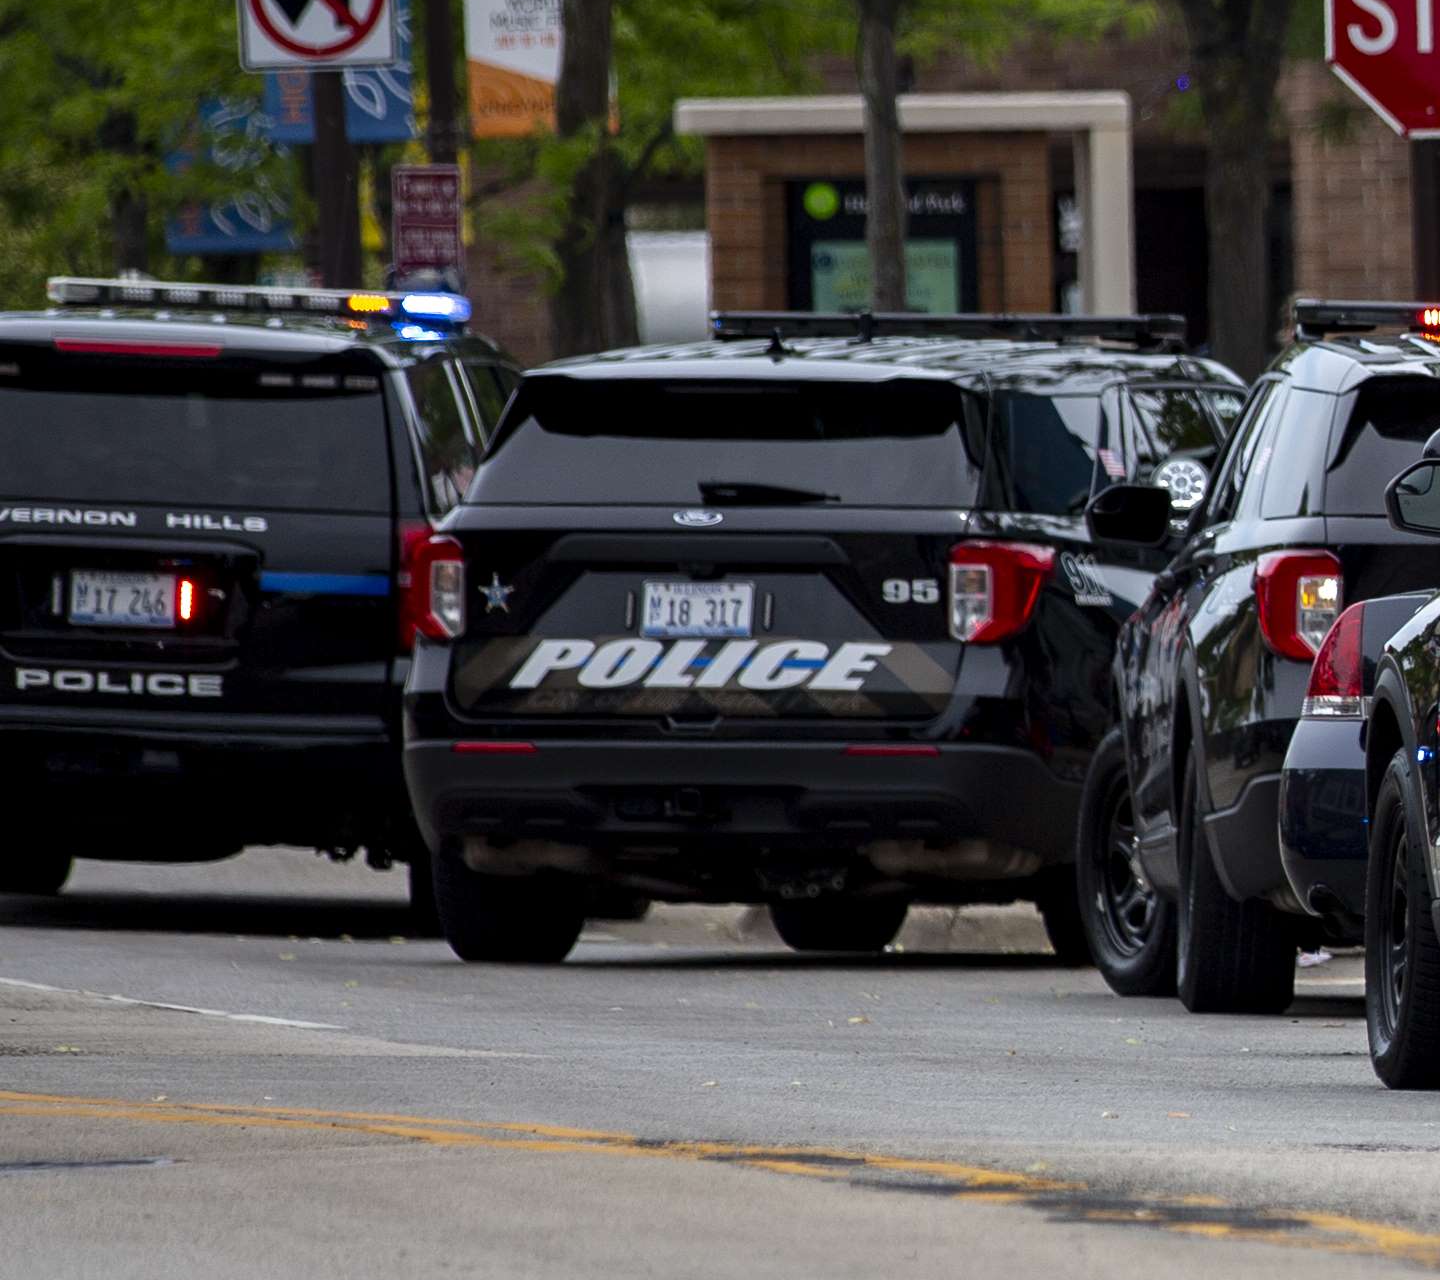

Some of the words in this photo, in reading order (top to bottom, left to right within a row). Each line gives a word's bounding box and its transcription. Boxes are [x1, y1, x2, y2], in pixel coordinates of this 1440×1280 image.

[166, 513, 269, 532] HILLS
[882, 578, 939, 604] 95
[666, 598, 691, 627] 18
[703, 598, 743, 628] 317
[509, 638, 893, 691] POLICE
[15, 668, 222, 697] POLICE
